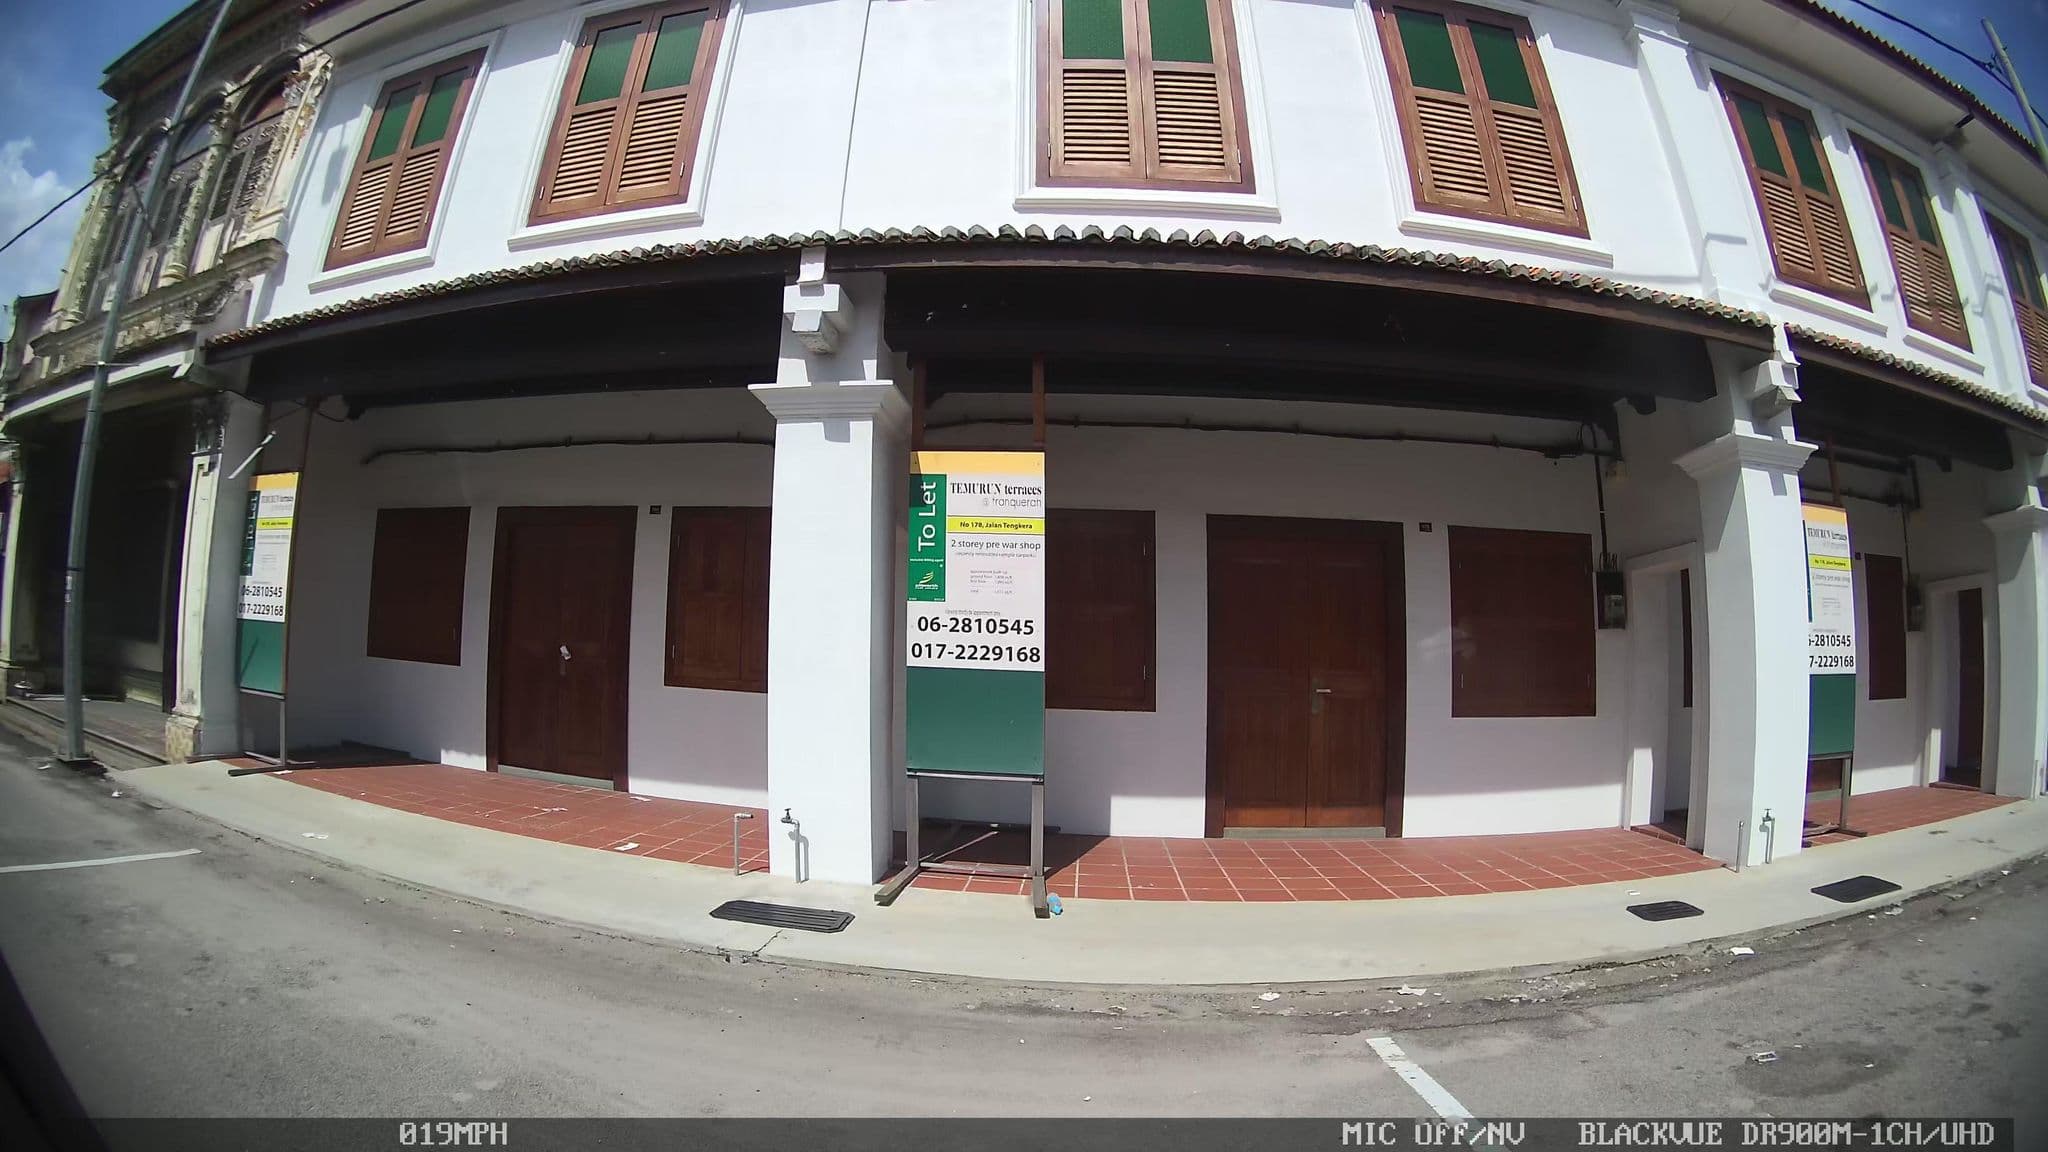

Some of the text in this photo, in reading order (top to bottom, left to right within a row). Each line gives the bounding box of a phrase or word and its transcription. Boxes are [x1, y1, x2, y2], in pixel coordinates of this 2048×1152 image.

[950, 483, 1042, 495] TEMURUN terraces
[919, 482, 936, 517] Let
[1003, 522, 1033, 530] Tengkera
[918, 524, 936, 552] To
[951, 539, 956, 547] 2
[958, 540, 984, 550] storey
[986, 542, 1000, 550] pre
[1020, 540, 1041, 551] shop
[917, 616, 1034, 635] 06-2810545
[911, 642, 1041, 662] 017-2229168
